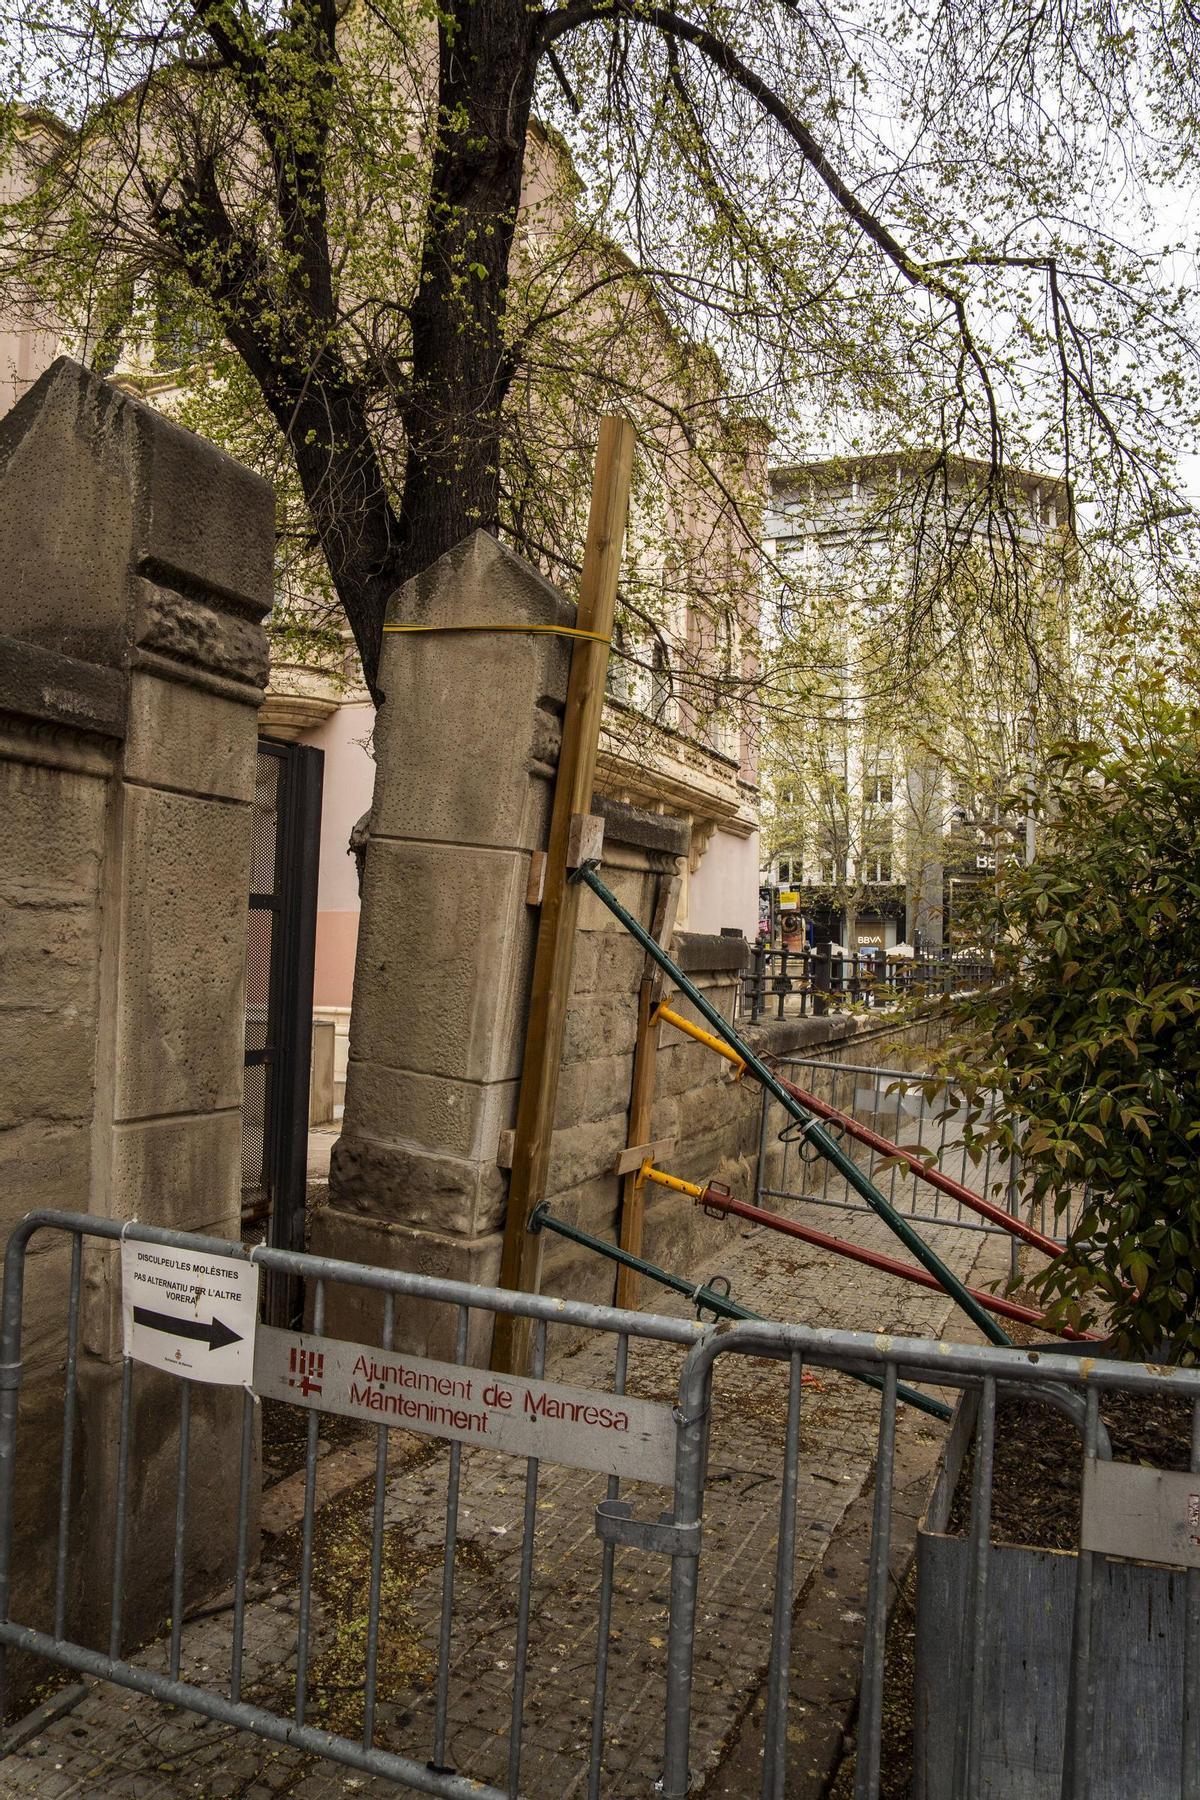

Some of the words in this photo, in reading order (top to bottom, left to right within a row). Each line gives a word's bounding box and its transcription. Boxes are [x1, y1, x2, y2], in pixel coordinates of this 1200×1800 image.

[976, 853, 1021, 869] BBA
[857, 936, 882, 944] BBVA
[137, 1252, 175, 1268] DISCULPEU
[176, 1261, 191, 1271] LES
[133, 1272, 146, 1281] PAS
[147, 1275, 188, 1292] ALTERNATIU
[189, 1285, 206, 1296] PER
[208, 1288, 242, 1302] L'ALTRE
[166, 1291, 196, 1305] VORERA
[352, 1354, 473, 1401] Ajuntament
[482, 1383, 513, 1409] de
[523, 1389, 630, 1433] Manresa
[350, 1382, 489, 1433] Manteniment
